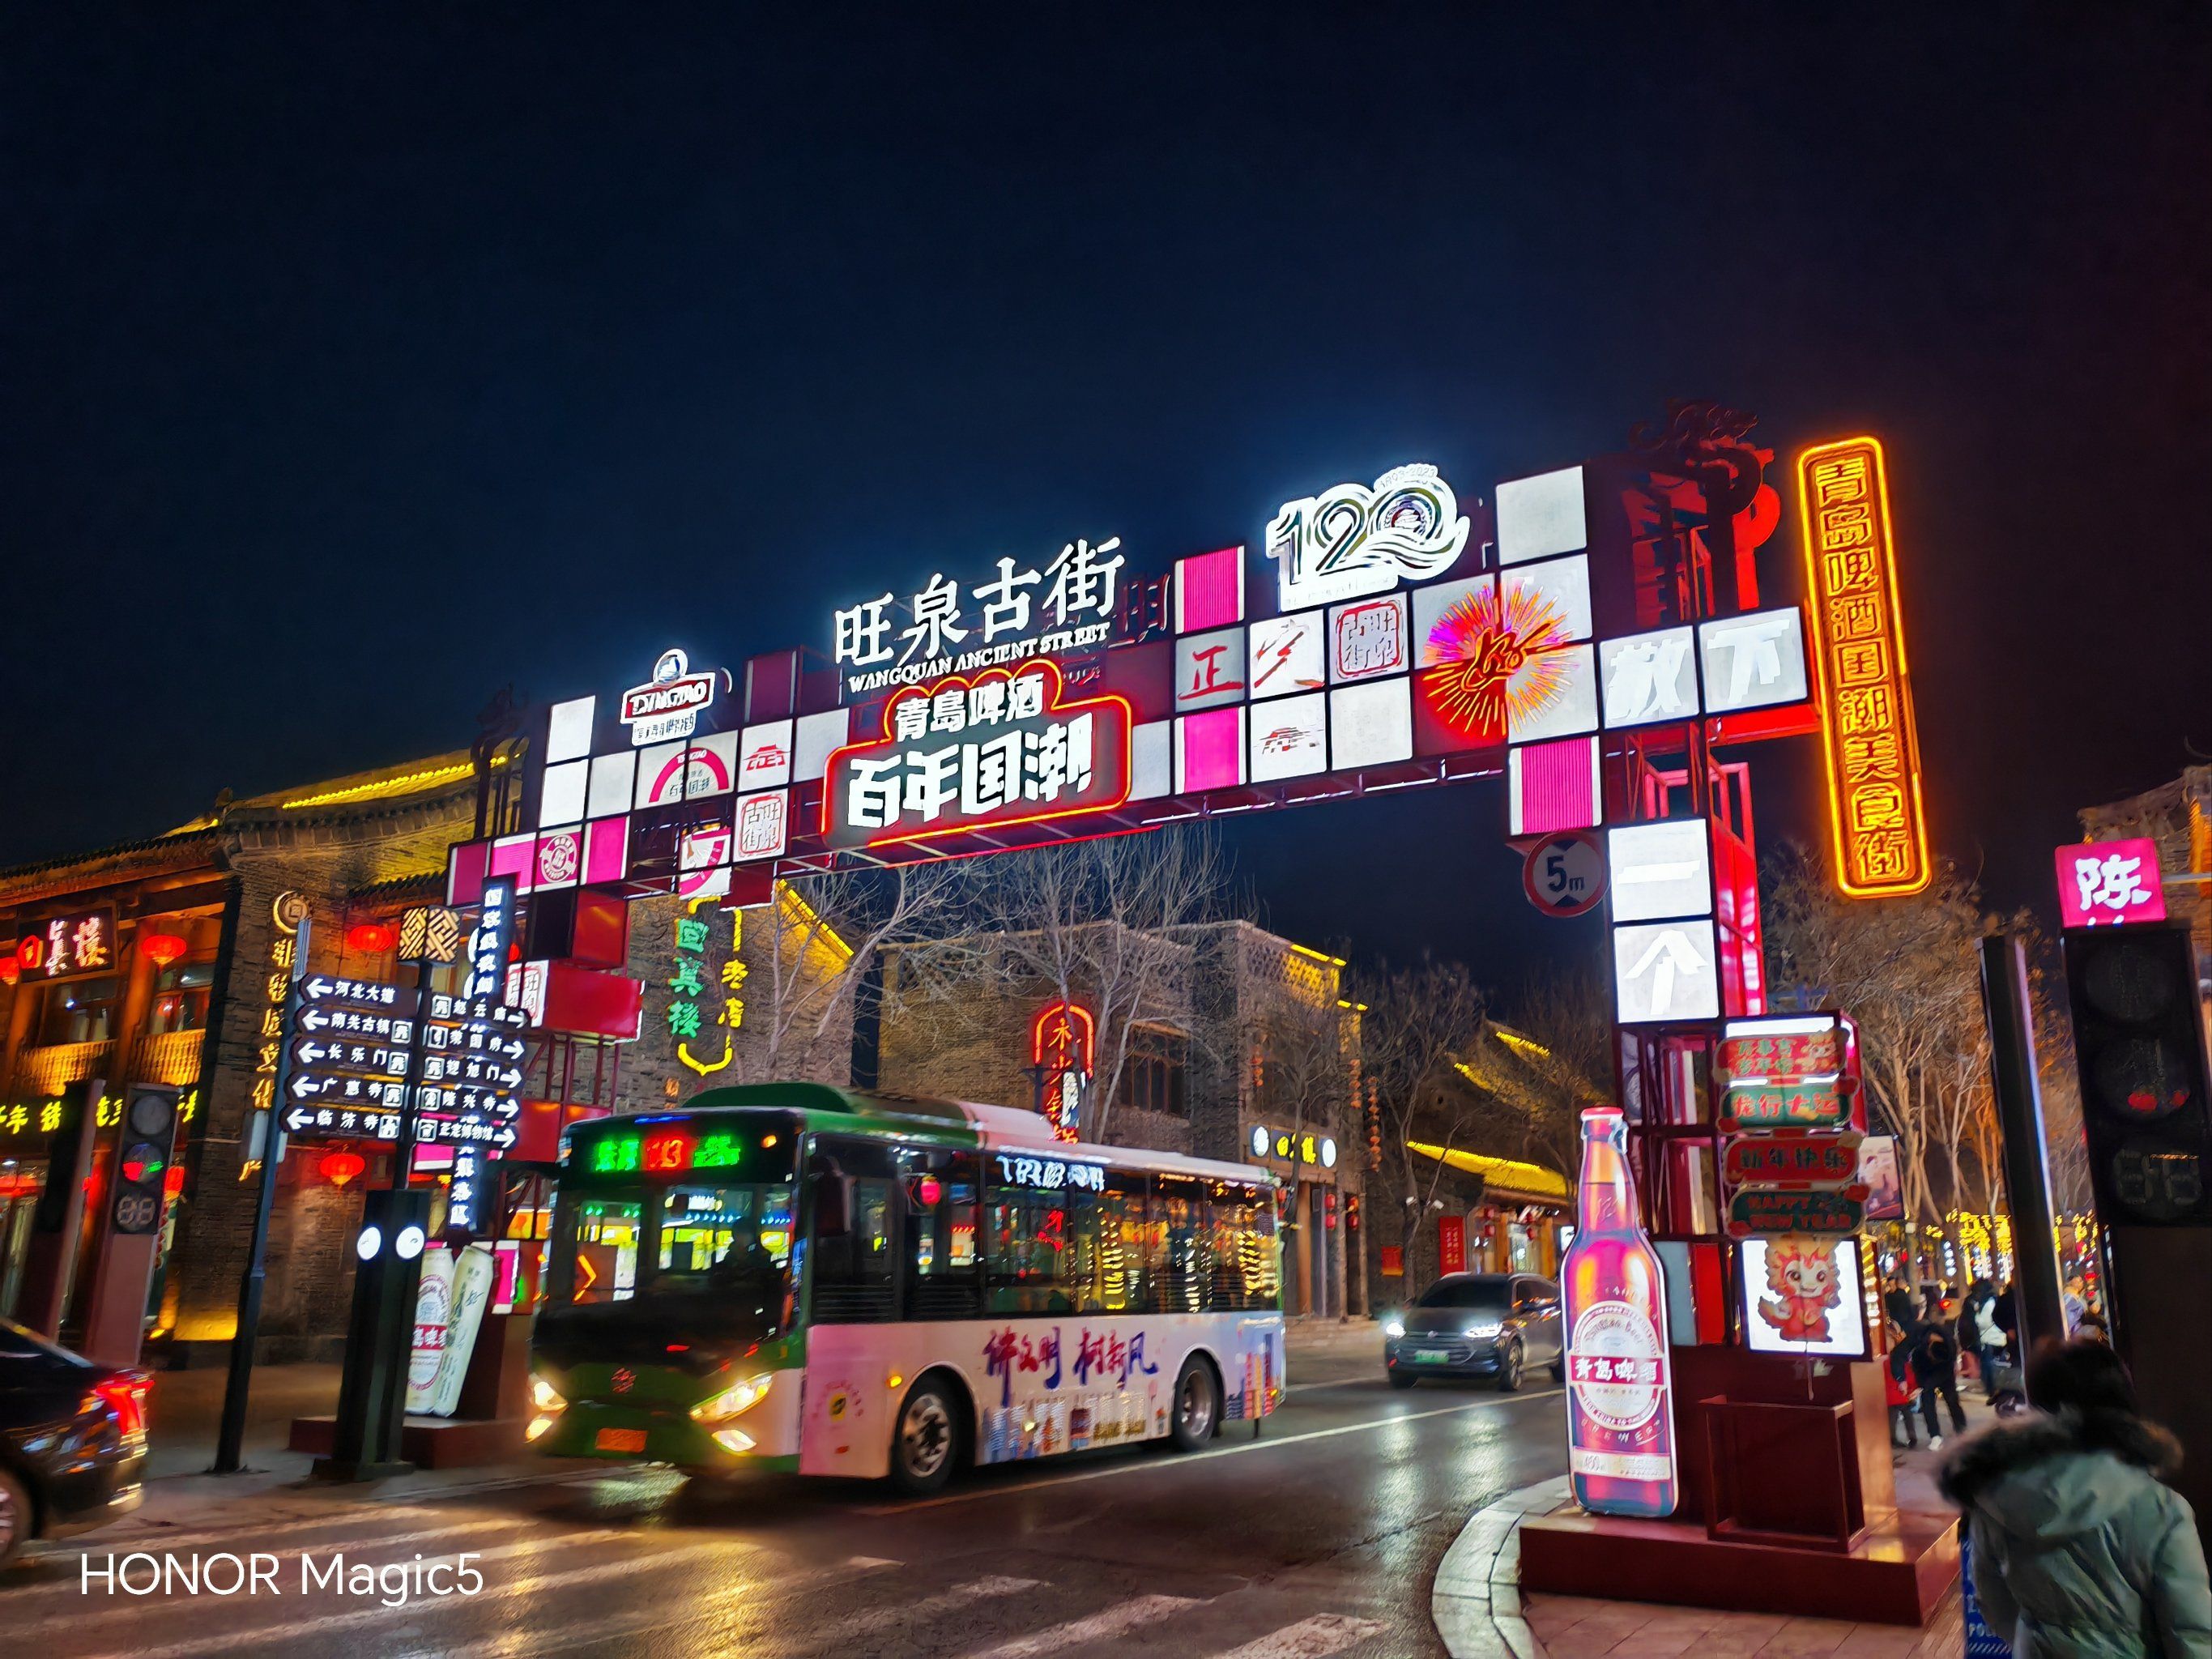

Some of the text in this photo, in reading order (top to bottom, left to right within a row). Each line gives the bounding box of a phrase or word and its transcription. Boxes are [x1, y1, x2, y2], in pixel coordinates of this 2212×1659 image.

[835, 536, 1126, 666] 旺泉古街
[848, 622, 1110, 693] WANGQUAN ANCIENT STREET
[1177, 645, 1245, 701] 正
[847, 712, 1093, 830] 百年国潮
[335, 980, 395, 1004] 河北大道
[331, 1013, 390, 1034] 南关古镇
[450, 1030, 502, 1051] 荣国府
[328, 1043, 388, 1066] 长乐门
[445, 1060, 500, 1081] 迎旭门
[322, 1077, 382, 1098] 广惠寺
[442, 1090, 496, 1111] 隆兴寺
[317, 1109, 378, 1131] 临济寺
[439, 1122, 494, 1141] 正定博物馆
